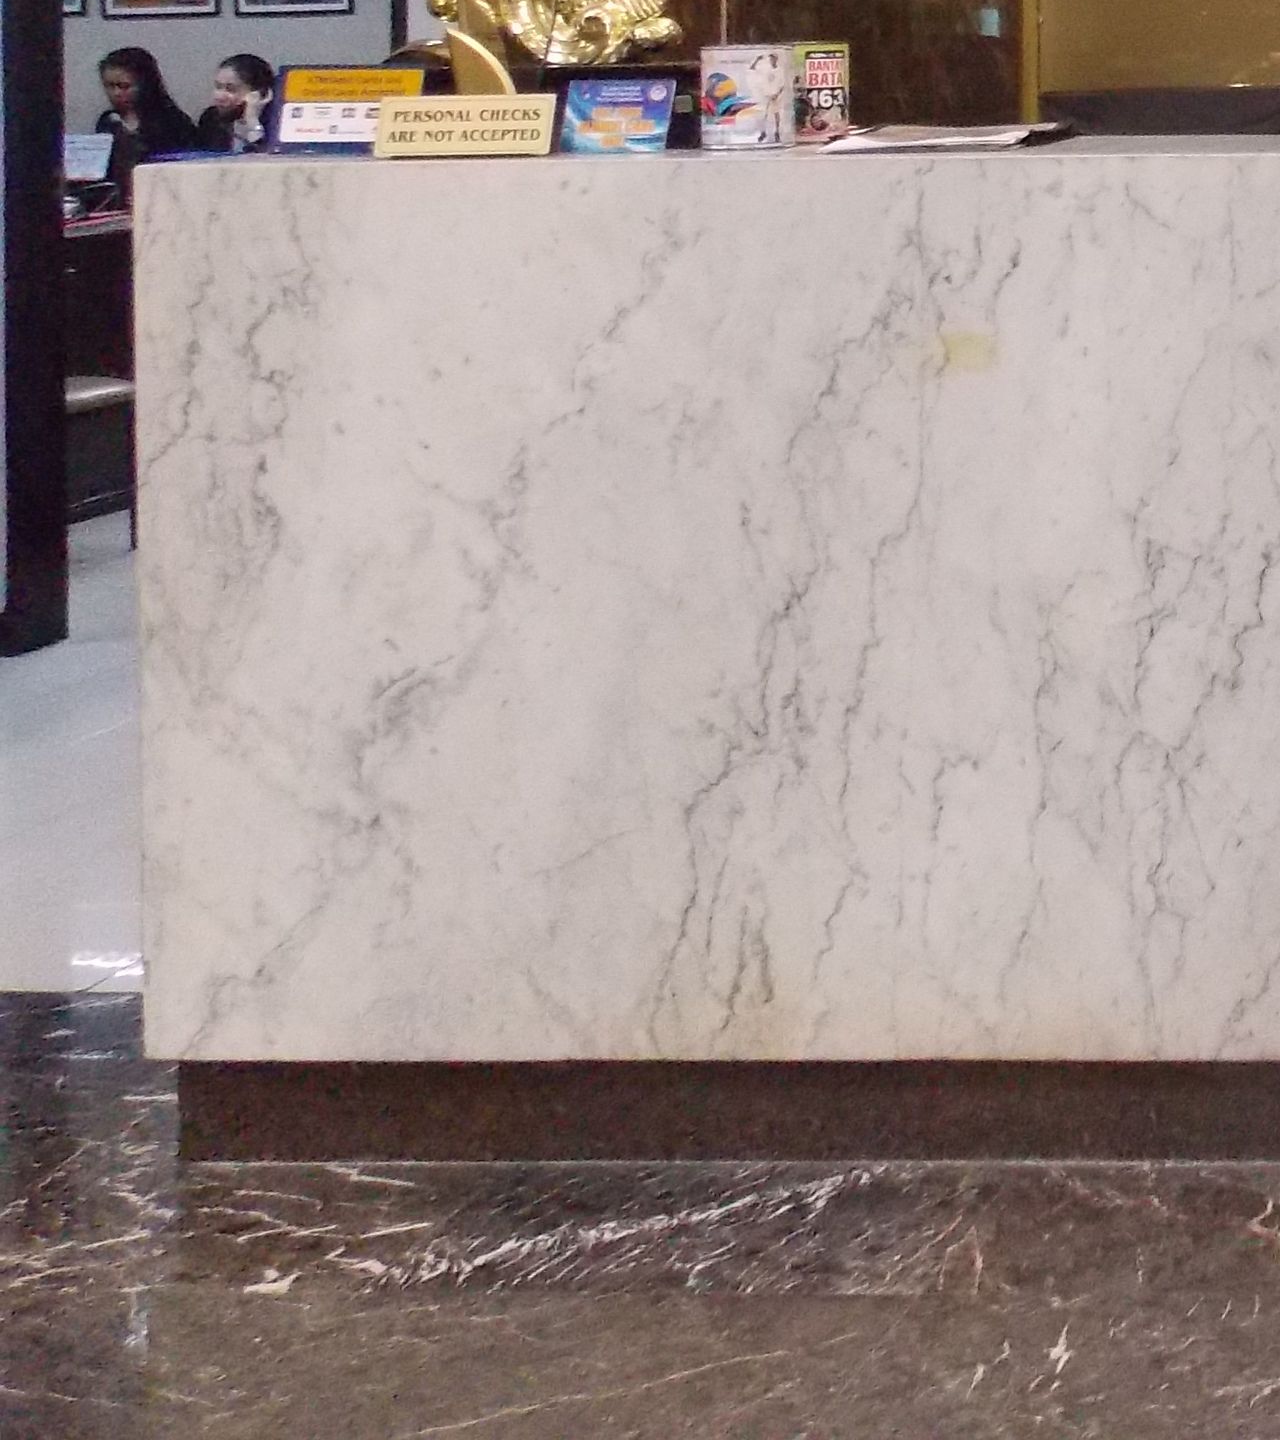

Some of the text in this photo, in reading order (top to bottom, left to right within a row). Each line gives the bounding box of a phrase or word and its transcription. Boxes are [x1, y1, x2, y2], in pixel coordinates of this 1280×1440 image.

[808, 72, 843, 86] BATA
[808, 89, 844, 108] 163
[393, 110, 473, 122] PERSONAL
[479, 109, 541, 122] CHECKS
[386, 130, 416, 143] ARE
[423, 130, 455, 143] NOT
[458, 128, 541, 142] ACCEPTED
